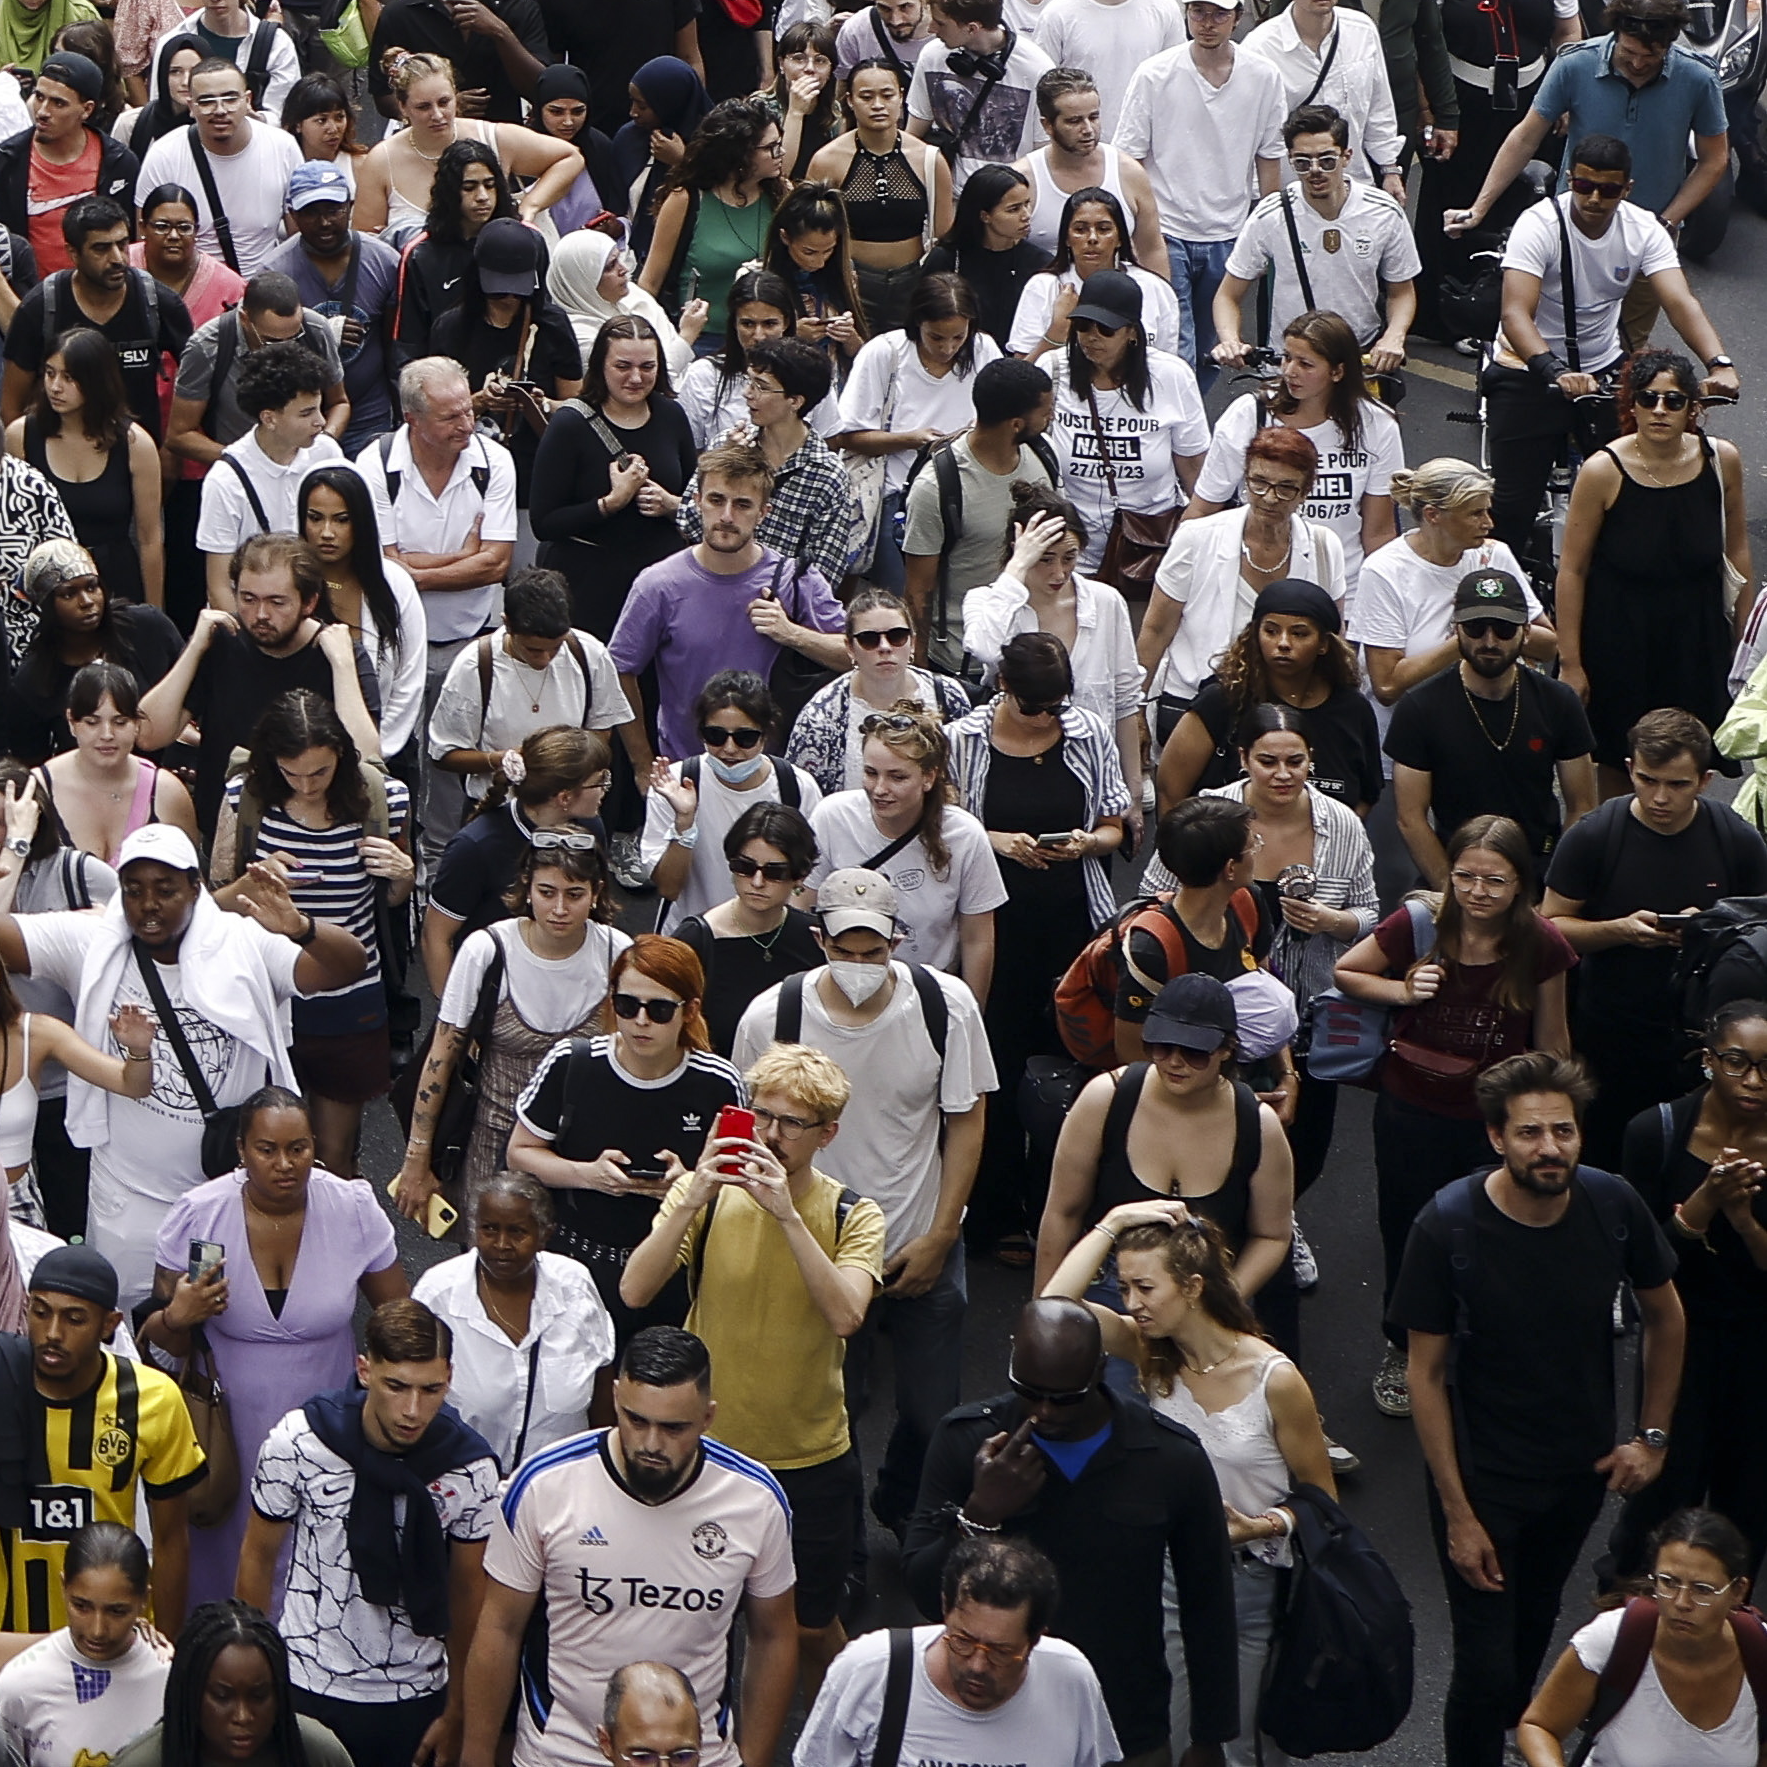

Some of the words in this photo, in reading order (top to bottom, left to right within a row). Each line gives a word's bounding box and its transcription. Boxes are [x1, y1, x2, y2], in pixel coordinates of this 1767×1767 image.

[1116, 418, 1160, 434] POUR
[1329, 452, 1368, 469] POUR
[100, 1433, 127, 1456] BVB
[31, 1498, 83, 1529] 1&1
[579, 1539, 608, 1547] adidas
[622, 1577, 724, 1612] Tezos
